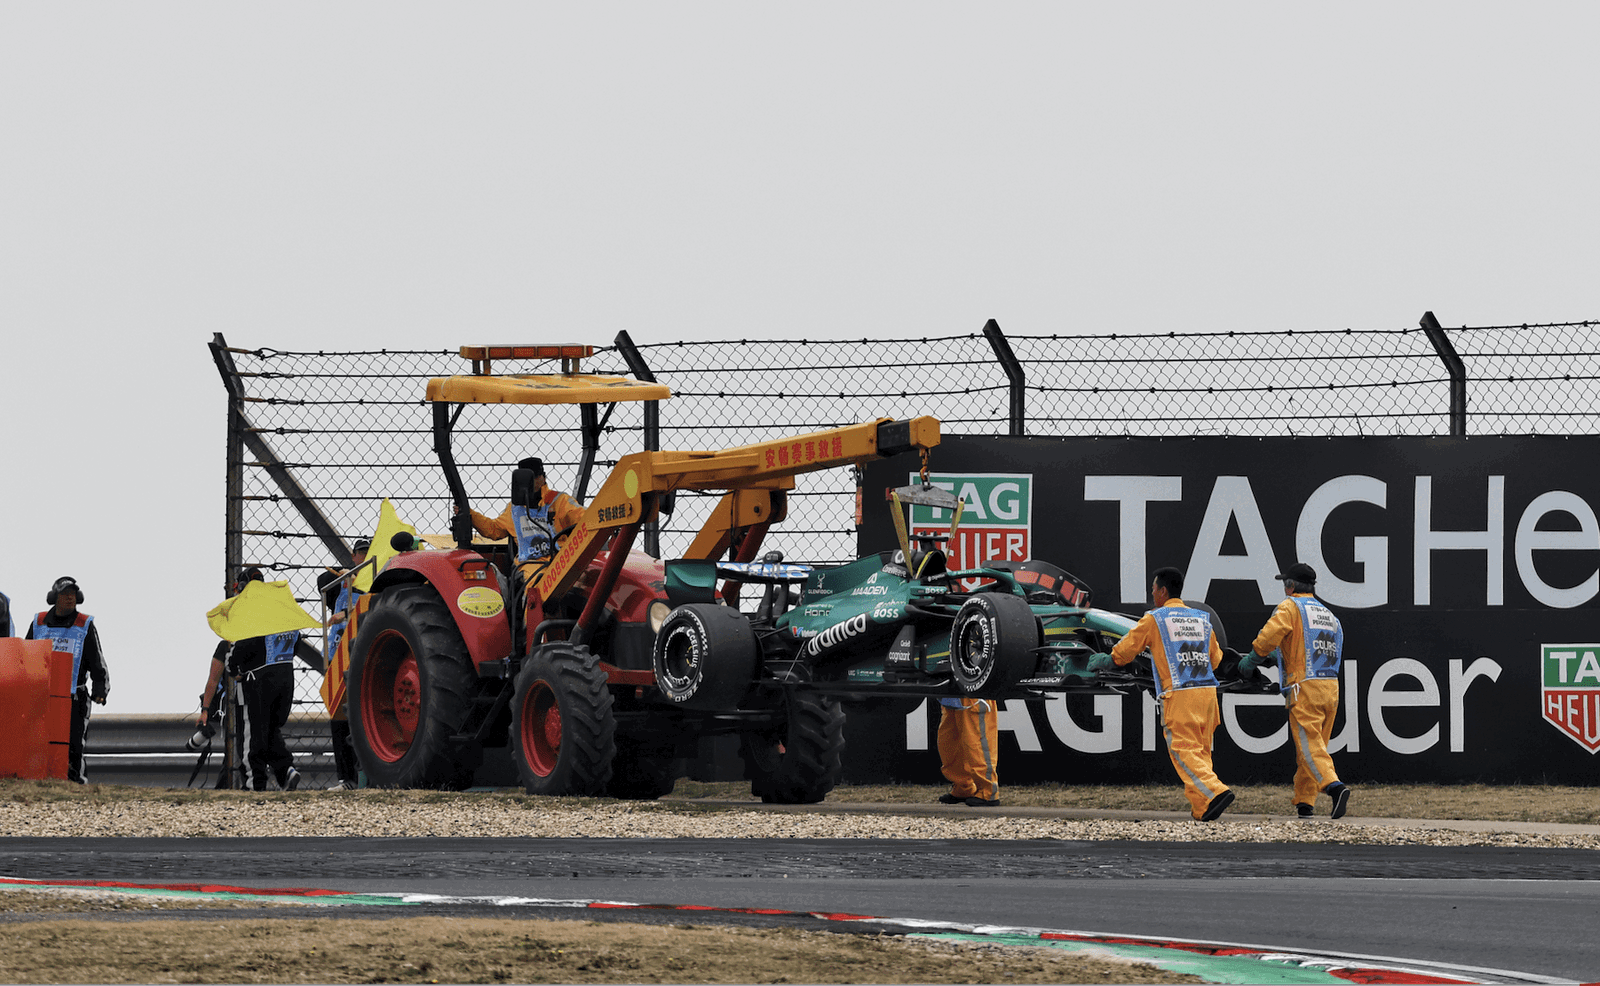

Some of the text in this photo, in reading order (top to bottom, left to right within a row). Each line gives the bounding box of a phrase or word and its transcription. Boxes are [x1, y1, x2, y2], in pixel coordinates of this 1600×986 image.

[542, 522, 589, 594] 4008895995
[917, 532, 1024, 592] EUER
[807, 613, 867, 656] aramco
[873, 609, 900, 619] BOSS
[1176, 651, 1210, 663] COURSE
